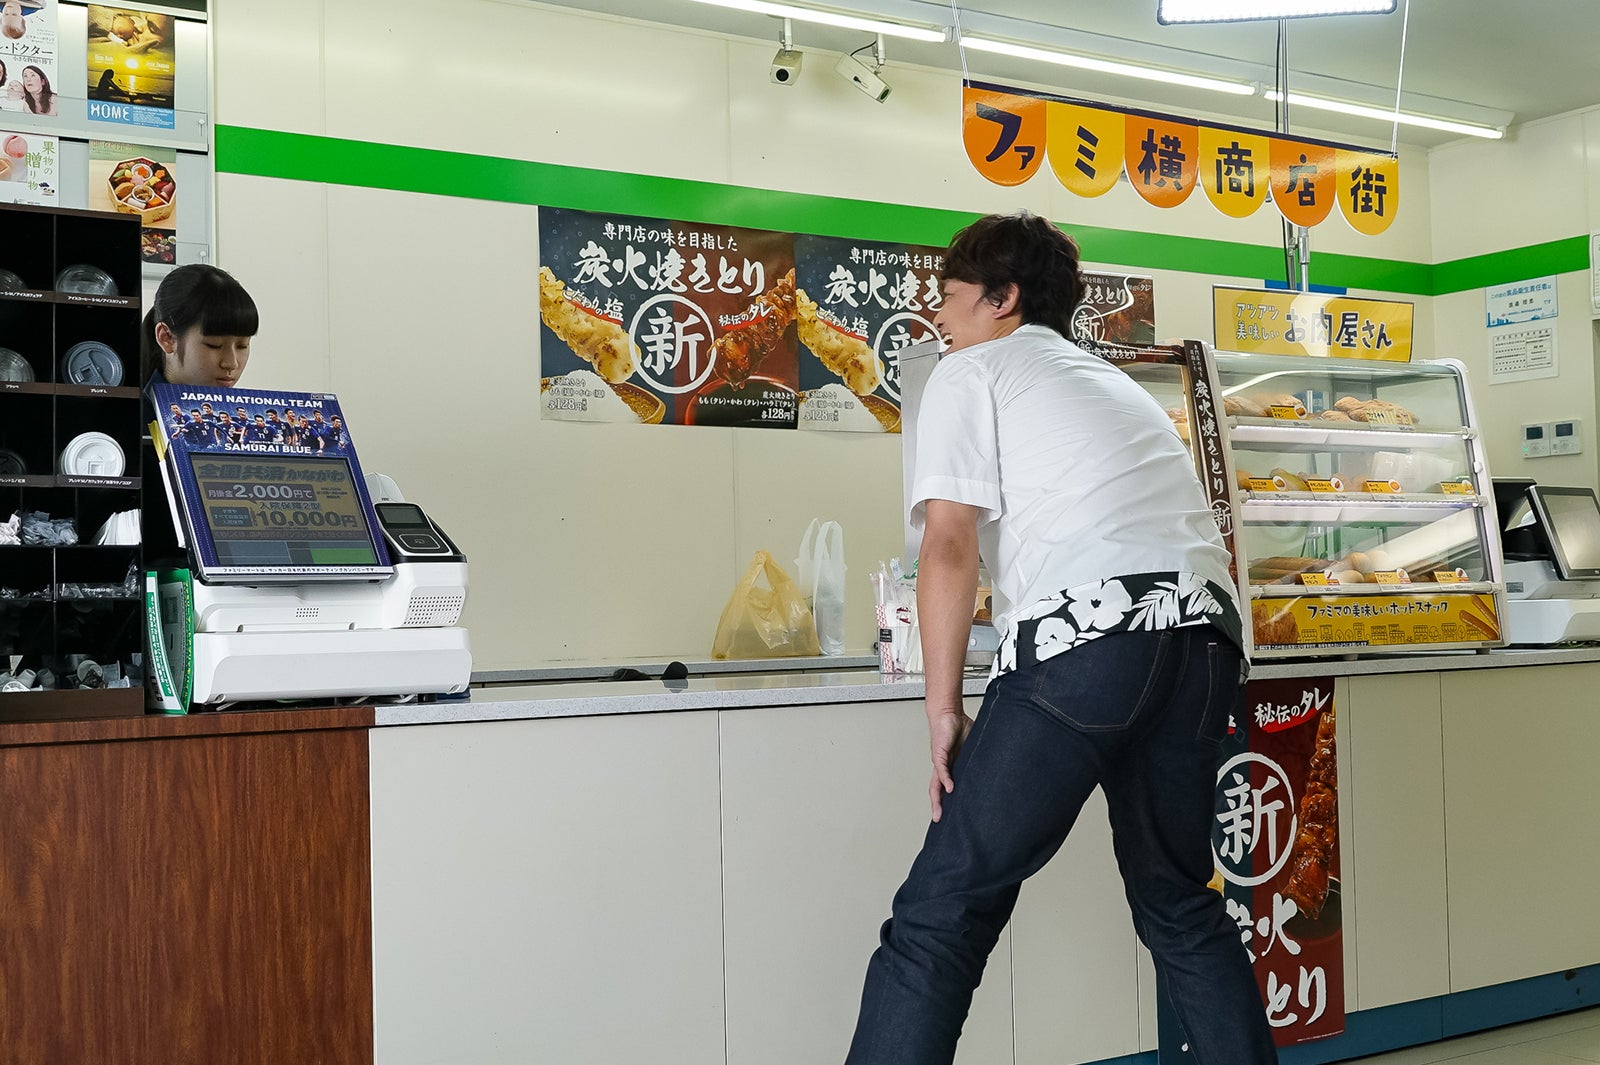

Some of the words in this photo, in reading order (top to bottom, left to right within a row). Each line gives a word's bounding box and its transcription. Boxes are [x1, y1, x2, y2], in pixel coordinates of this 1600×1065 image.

[0, 42, 53, 55] ・ドクター
[90, 103, 130, 122] HOME
[975, 102, 1388, 217] ファミ横商店街
[602, 221, 738, 252] 専門店の味を目指した
[573, 240, 765, 297] 炭火焼きとり
[562, 286, 625, 321] こだわりの塩
[718, 302, 773, 327] 秘伝のタレ
[1235, 303, 1280, 320] アツアツ
[640, 306, 705, 381] 新
[1235, 320, 1280, 340] 美味しい
[1284, 307, 1392, 350] お肉屋さん
[180, 392, 223, 402] JAPAN
[226, 394, 288, 407] NATIONAL
[288, 399, 323, 409] TEAM
[224, 442, 279, 453] SAMURAI
[282, 445, 312, 455] BLUE
[1195, 379, 1225, 496] 炭火焼きとり
[1307, 601, 1449, 619] ファミマの美味しいホットスナック
[1254, 687, 1331, 728] 秘伝のタレ
[1216, 772, 1285, 866] 新
